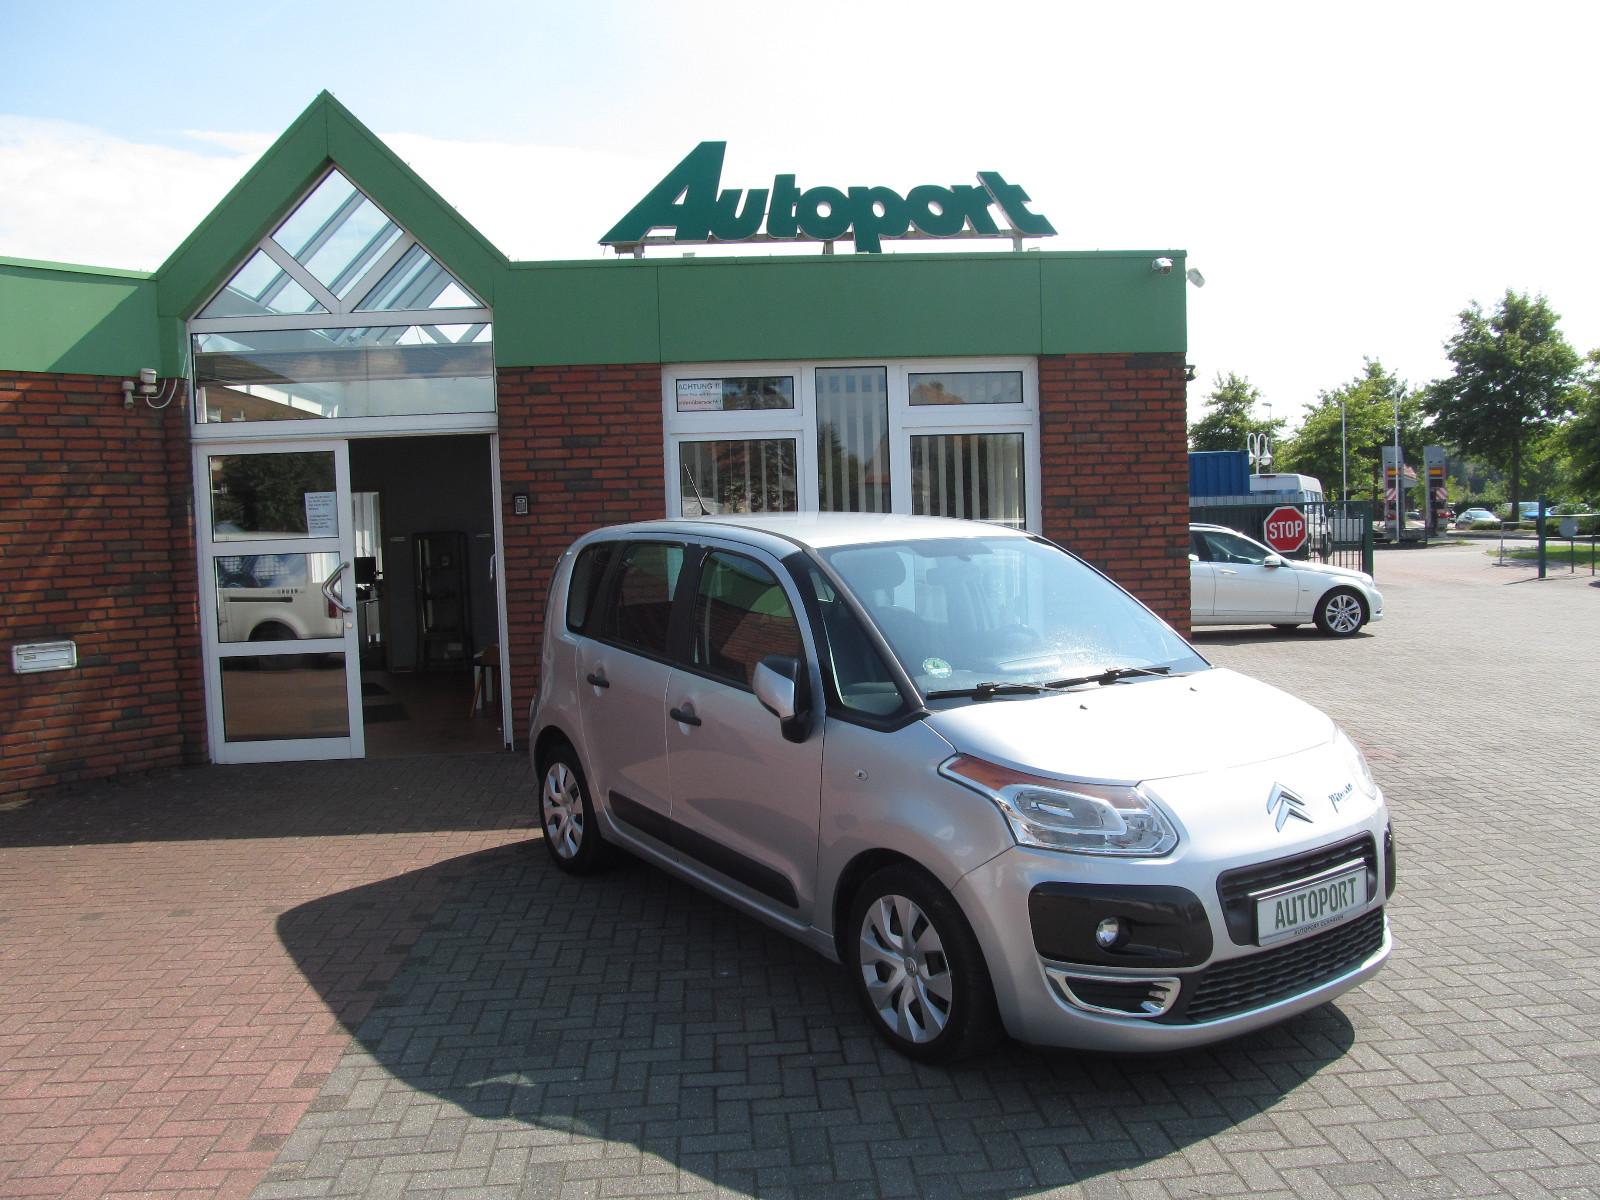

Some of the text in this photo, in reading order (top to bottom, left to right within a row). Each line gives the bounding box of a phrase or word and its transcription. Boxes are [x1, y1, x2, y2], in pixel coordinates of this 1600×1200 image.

[598, 140, 1058, 254] Autoport
[678, 382, 712, 390] ACHTUNG
[1269, 520, 1303, 539] STOP
[1275, 877, 1357, 930] AUTOPORT
